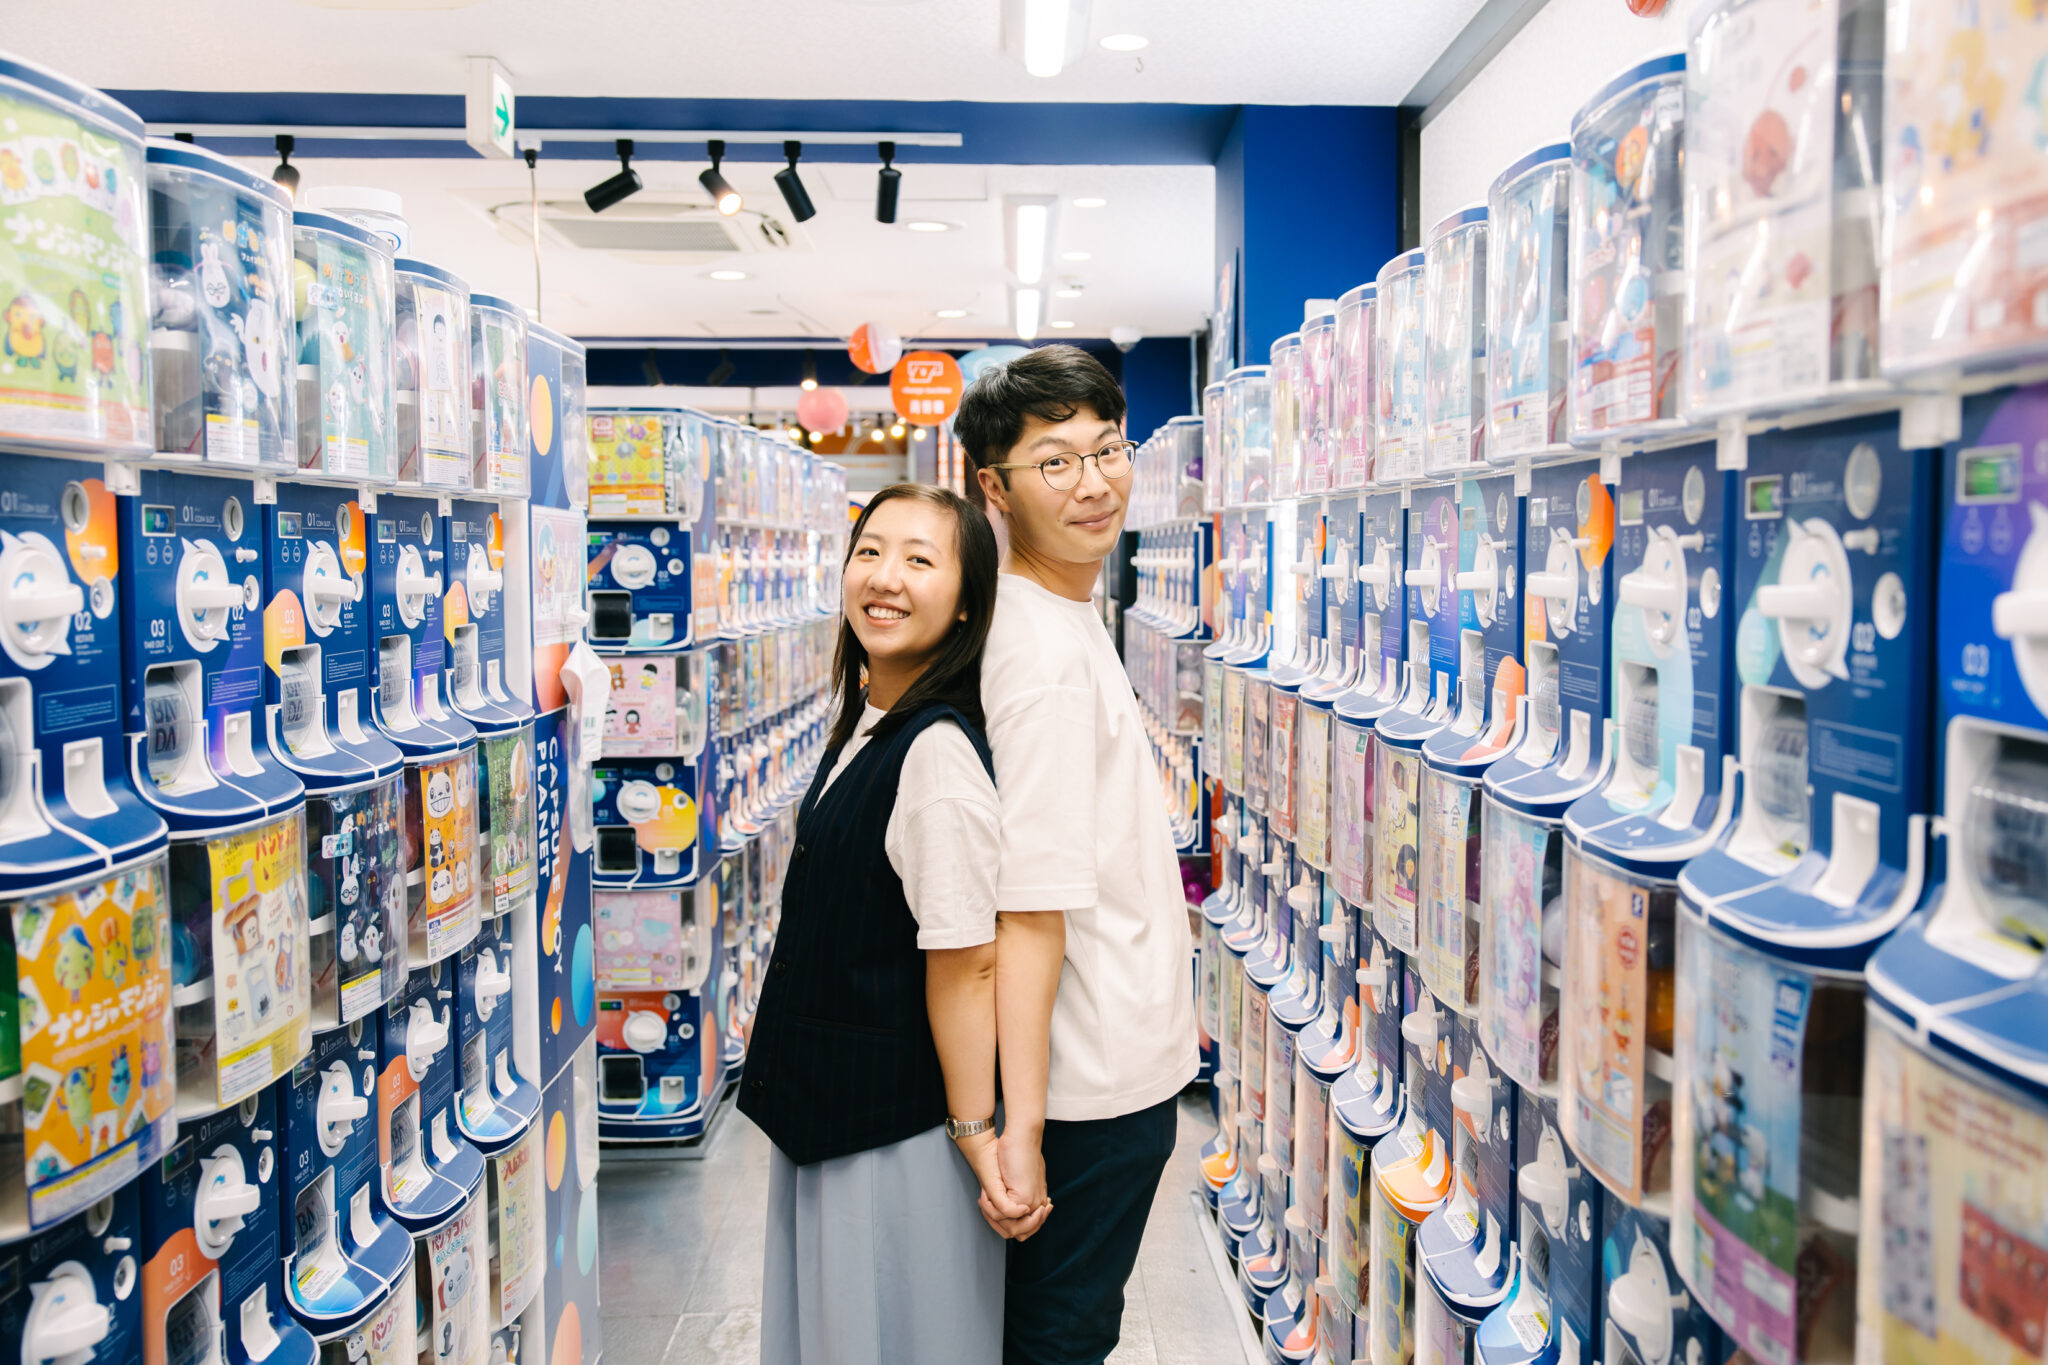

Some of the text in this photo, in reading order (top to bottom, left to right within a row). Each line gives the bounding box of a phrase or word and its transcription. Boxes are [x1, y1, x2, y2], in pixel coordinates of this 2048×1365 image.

[1, 490, 18, 513] 01
[182, 505, 194, 522] 01
[307, 512, 316, 527] 01
[399, 520, 406, 533] 01
[426, 593, 434, 606] 02
[232, 606, 244, 621] 02
[382, 604, 391, 618] 03
[74, 611, 92, 632] 02
[150, 619, 166, 638] 03
[536, 741, 550, 877] PLANET
[549, 736, 563, 975] CAPSULE TOY
[48, 974, 164, 1048] ナンジャモンジャ
[464, 1012, 472, 1026] 03
[320, 1040, 329, 1056] 01
[392, 1072, 400, 1088] 03
[200, 1121, 211, 1141] 01
[299, 1150, 309, 1168] 03
[169, 1253, 184, 1276] 03
